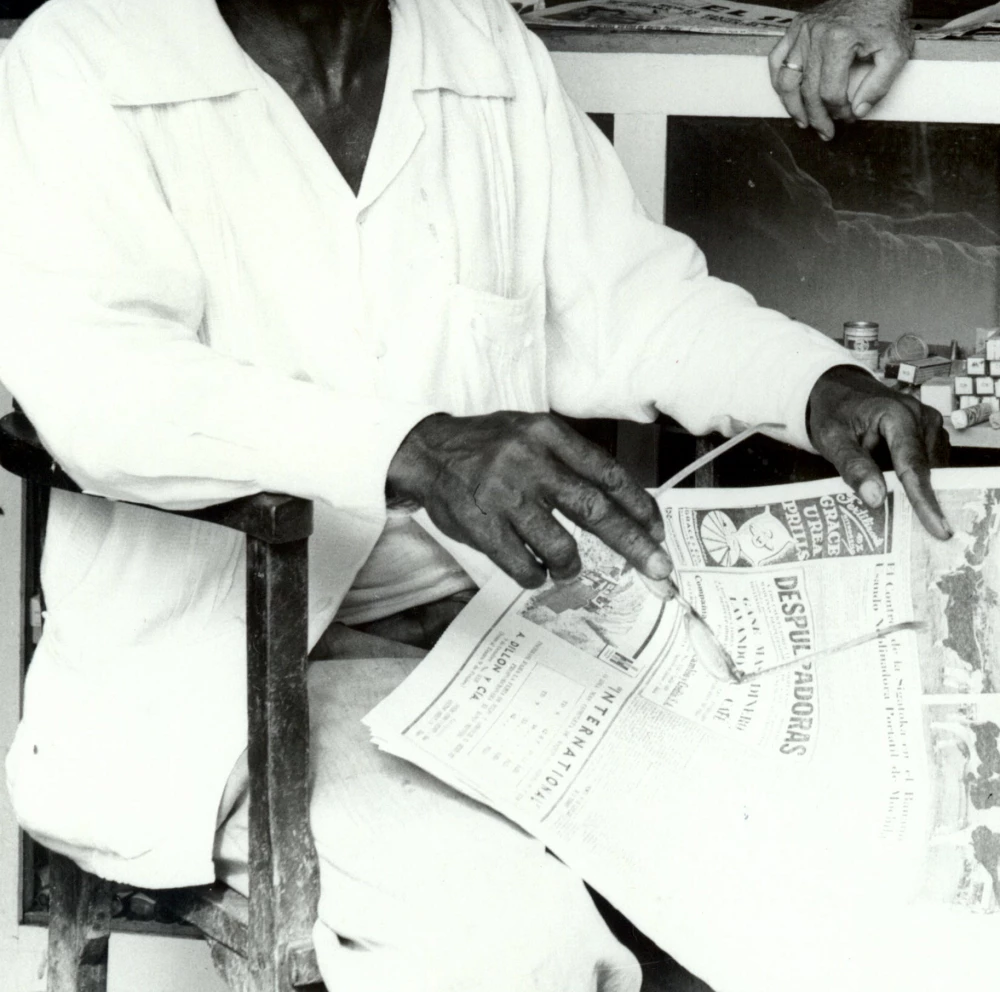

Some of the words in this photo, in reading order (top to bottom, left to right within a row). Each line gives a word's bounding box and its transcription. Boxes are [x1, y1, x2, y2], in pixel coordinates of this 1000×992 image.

[781, 500, 810, 562] PRILLS
[803, 504, 823, 557] UREA
[819, 495, 841, 557] GRACE
[491, 638, 519, 674] DILLON
